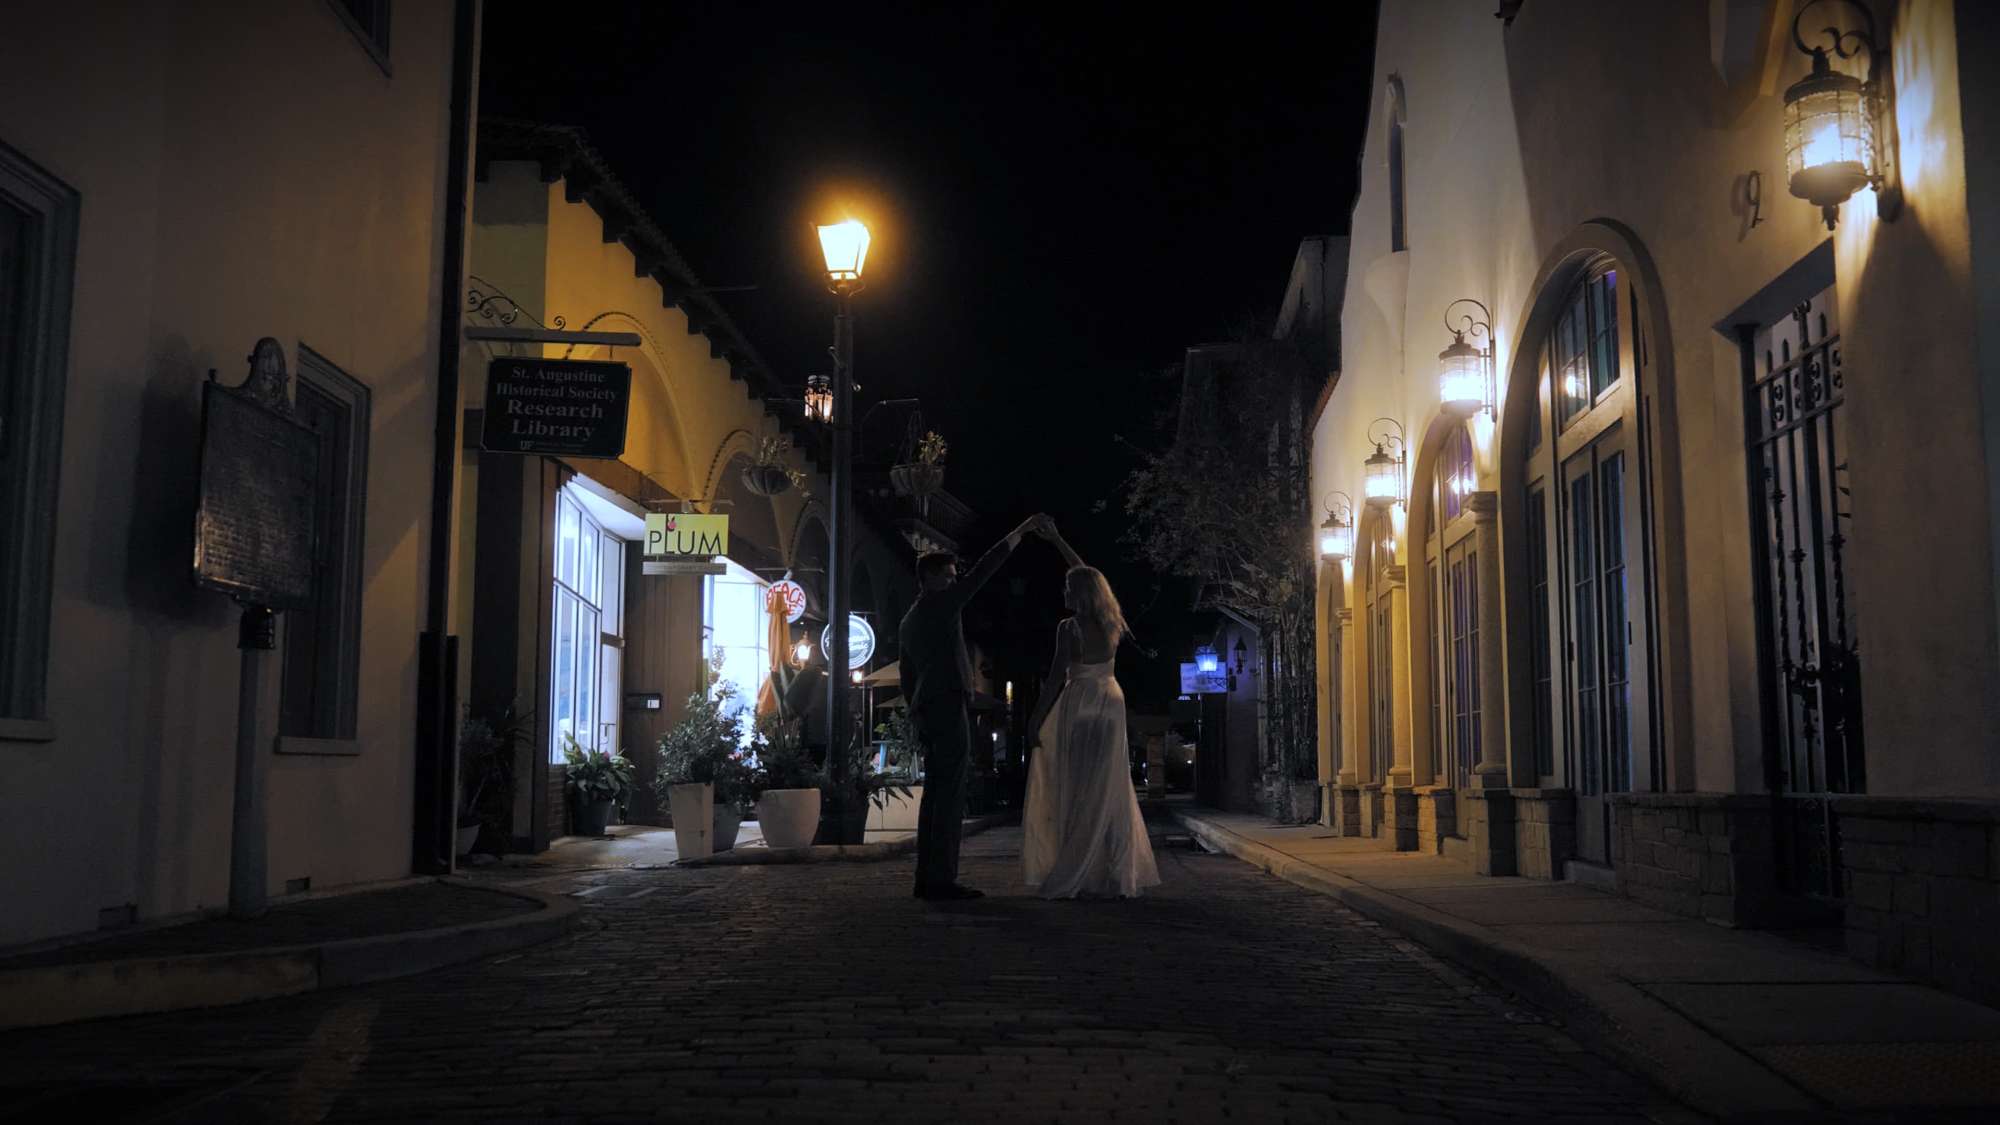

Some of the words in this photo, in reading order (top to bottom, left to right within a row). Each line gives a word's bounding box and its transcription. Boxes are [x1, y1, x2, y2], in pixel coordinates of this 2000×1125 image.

[1745, 170, 1764, 228] 9
[512, 366, 530, 379] St.
[535, 367, 607, 383] Augustine
[496, 382, 565, 398] Historical
[568, 385, 617, 403] Society
[507, 399, 604, 418] Research
[512, 419, 596, 441] Library
[649, 514, 722, 555] PLUM
